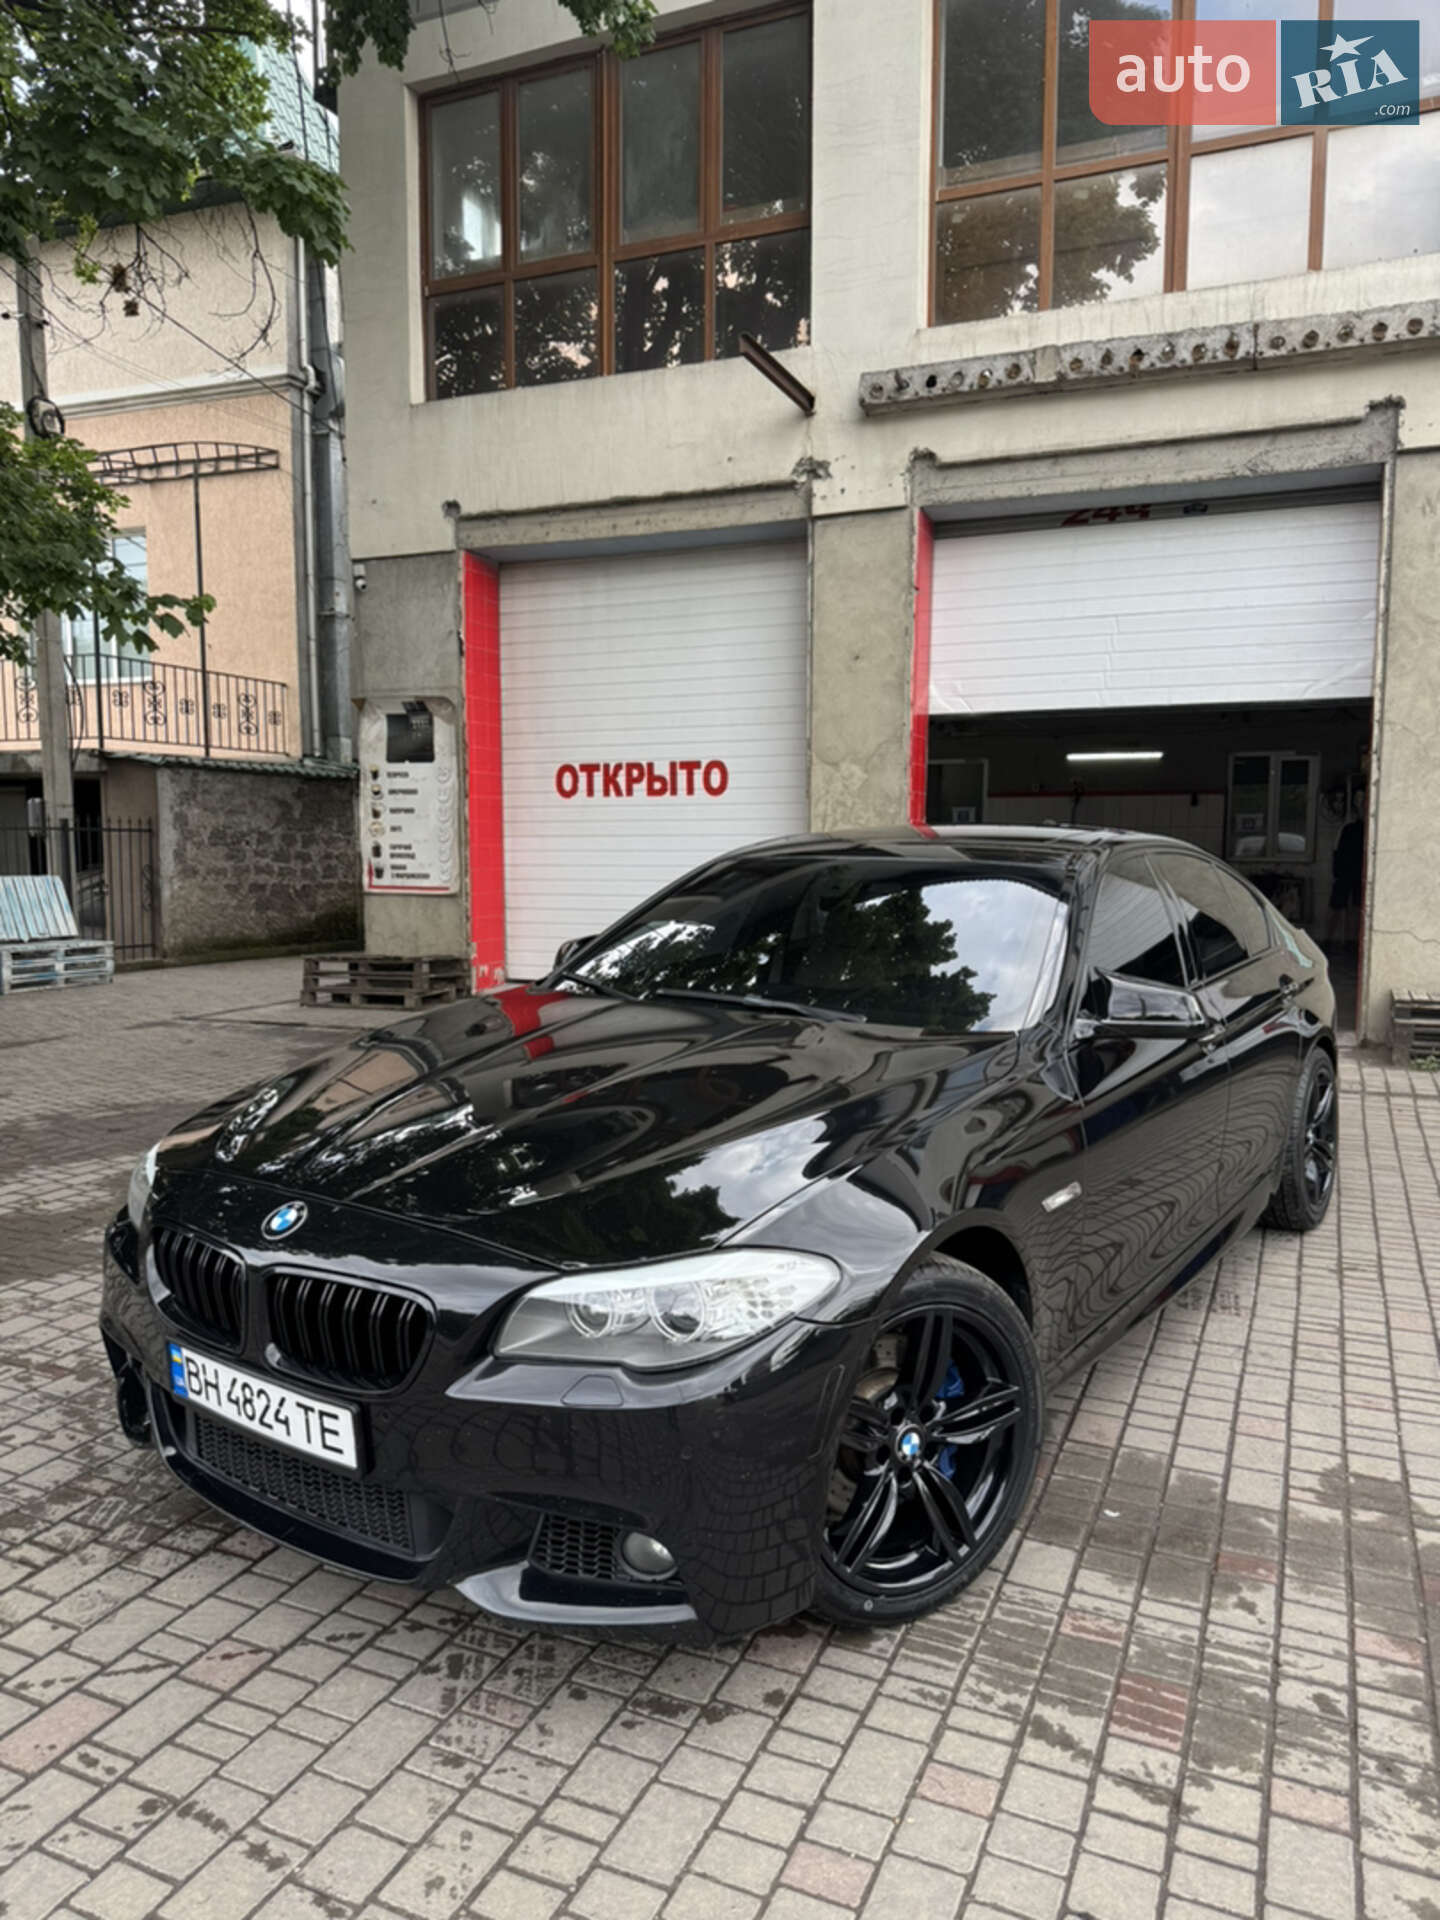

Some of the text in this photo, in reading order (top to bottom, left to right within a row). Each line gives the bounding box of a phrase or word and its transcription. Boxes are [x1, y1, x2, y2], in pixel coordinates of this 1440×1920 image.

[555, 759, 729, 799] ОТКРЫТО
[185, 1355, 345, 1455] BH 4824 TE
